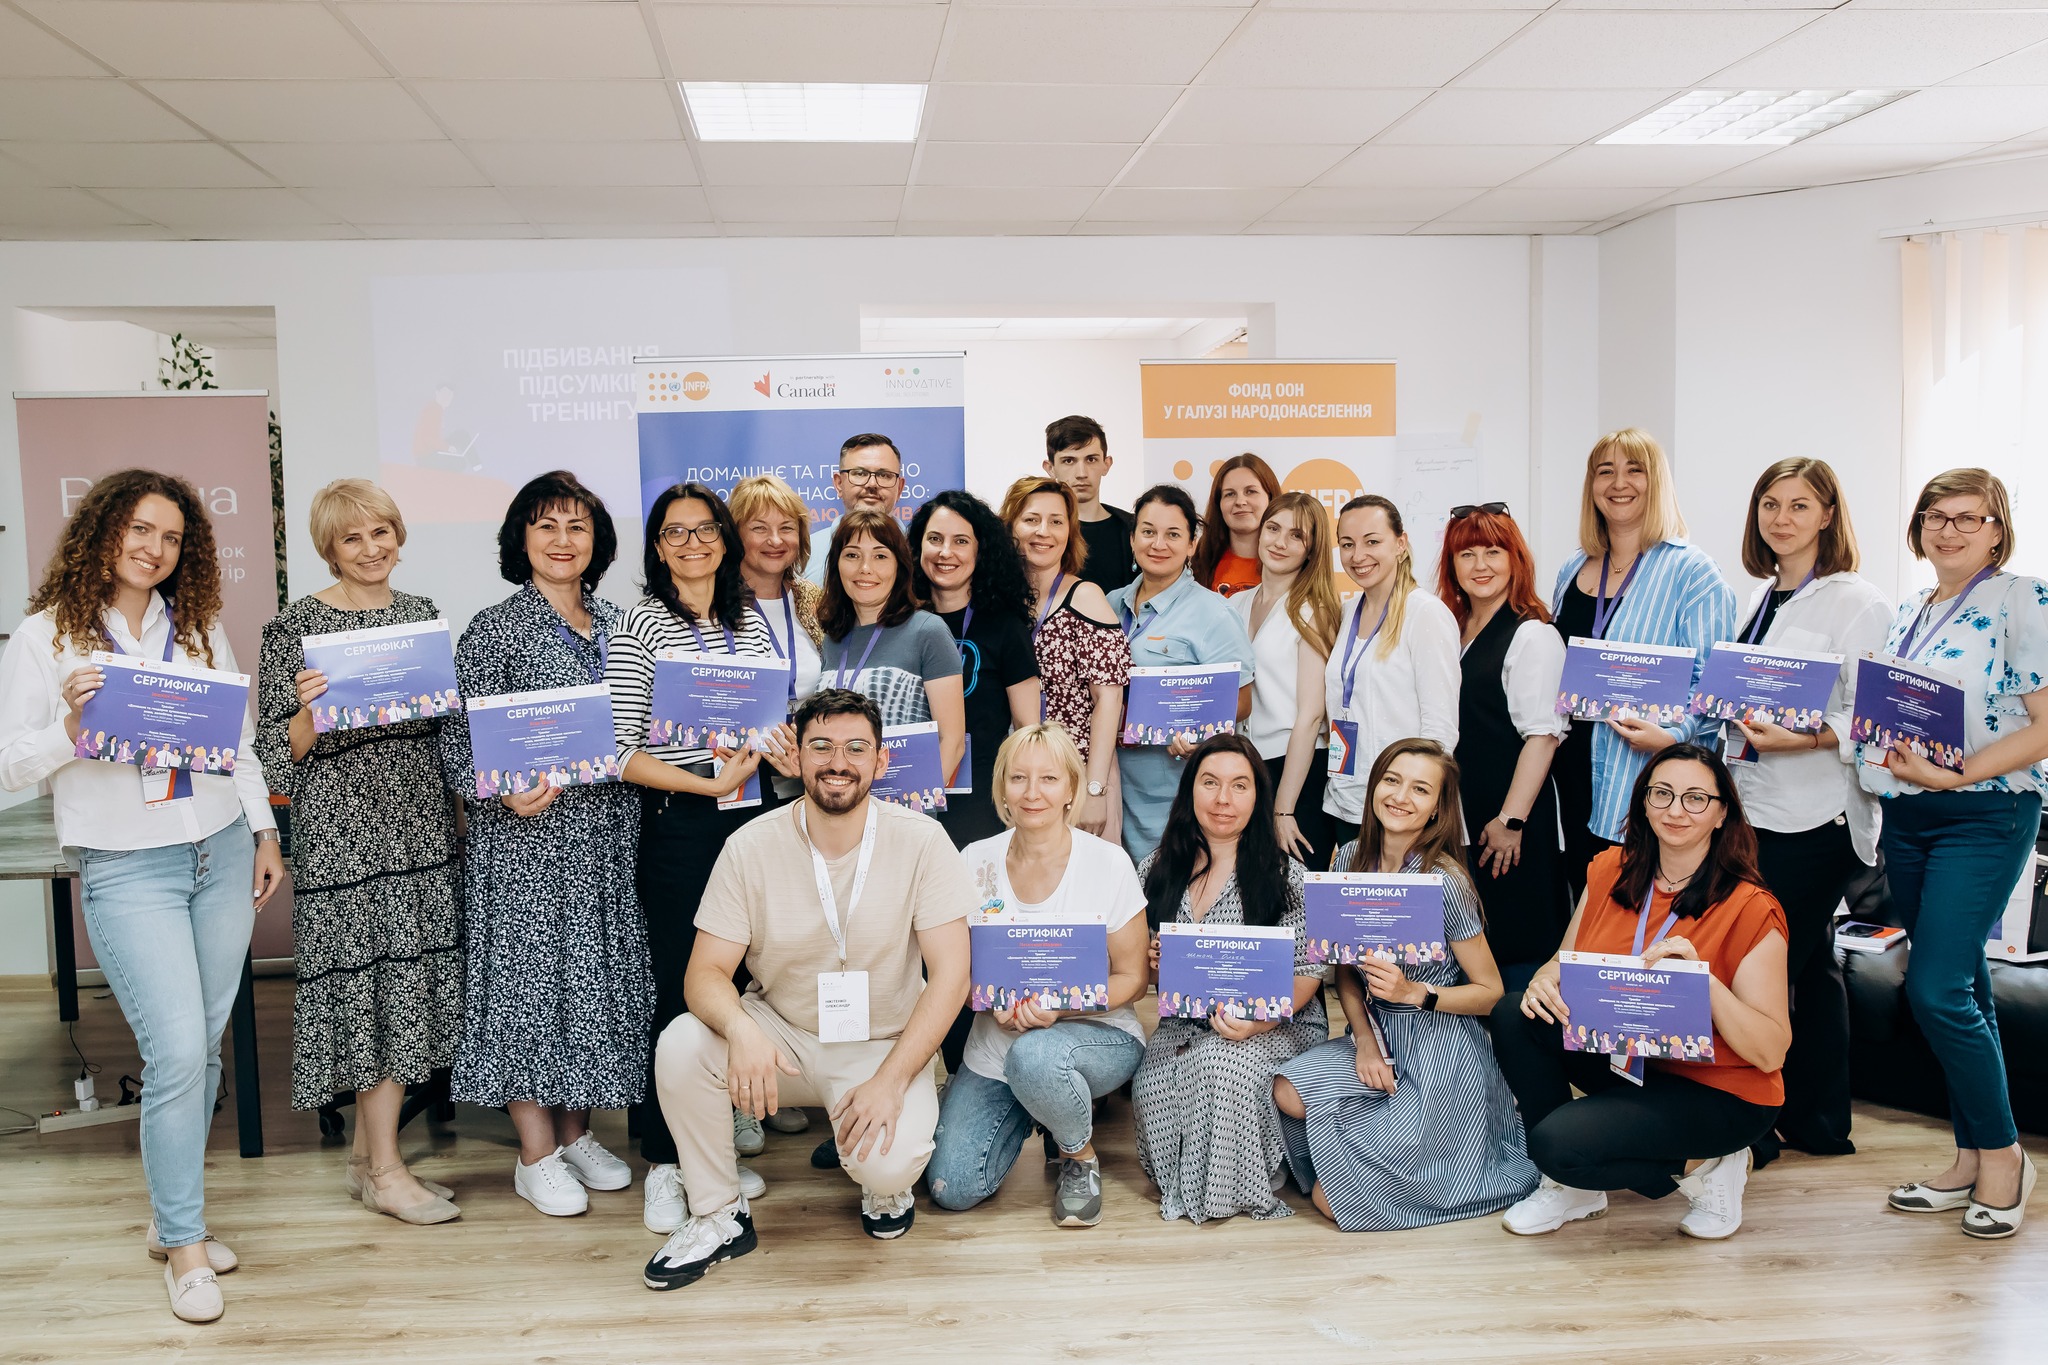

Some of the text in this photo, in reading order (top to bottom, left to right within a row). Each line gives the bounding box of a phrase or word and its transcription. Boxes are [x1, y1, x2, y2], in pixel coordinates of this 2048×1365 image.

[682, 380, 711, 392] UNFPA
[777, 383, 836, 398] Canada
[1228, 383, 1304, 399] ФОНД ООН
[528, 400, 637, 422] ТРЕНІНГУ
[1164, 403, 1372, 421] У ГАЛУЗІ НАРОДОНАСЕЛЕННЯ
[685, 465, 787, 483] ДОМАШНЄ
[791, 465, 813, 479] ТА
[344, 638, 415, 657] СЕРТИФІКАТ
[1600, 652, 1662, 666] СЕРТИФІКАТ
[1743, 655, 1808, 670] СЕРТИФІКАТ
[691, 667, 757, 680] СЕРТИФІКАТ
[133, 674, 211, 695] СЕРТИФІКАТ
[1160, 676, 1214, 687] СЕРТИФІКАТ
[1888, 670, 1941, 694] СЕРТИФІКАТ
[507, 702, 577, 719] СЕРТИФІКАТ
[1340, 887, 1408, 898] СЕРТИФІКАТ
[1007, 928, 1074, 938] СЕРТИФІКАТ
[1195, 939, 1262, 951] СЕРТИФІКАТ
[1598, 970, 1672, 985] СЕРТИФІКАТ
